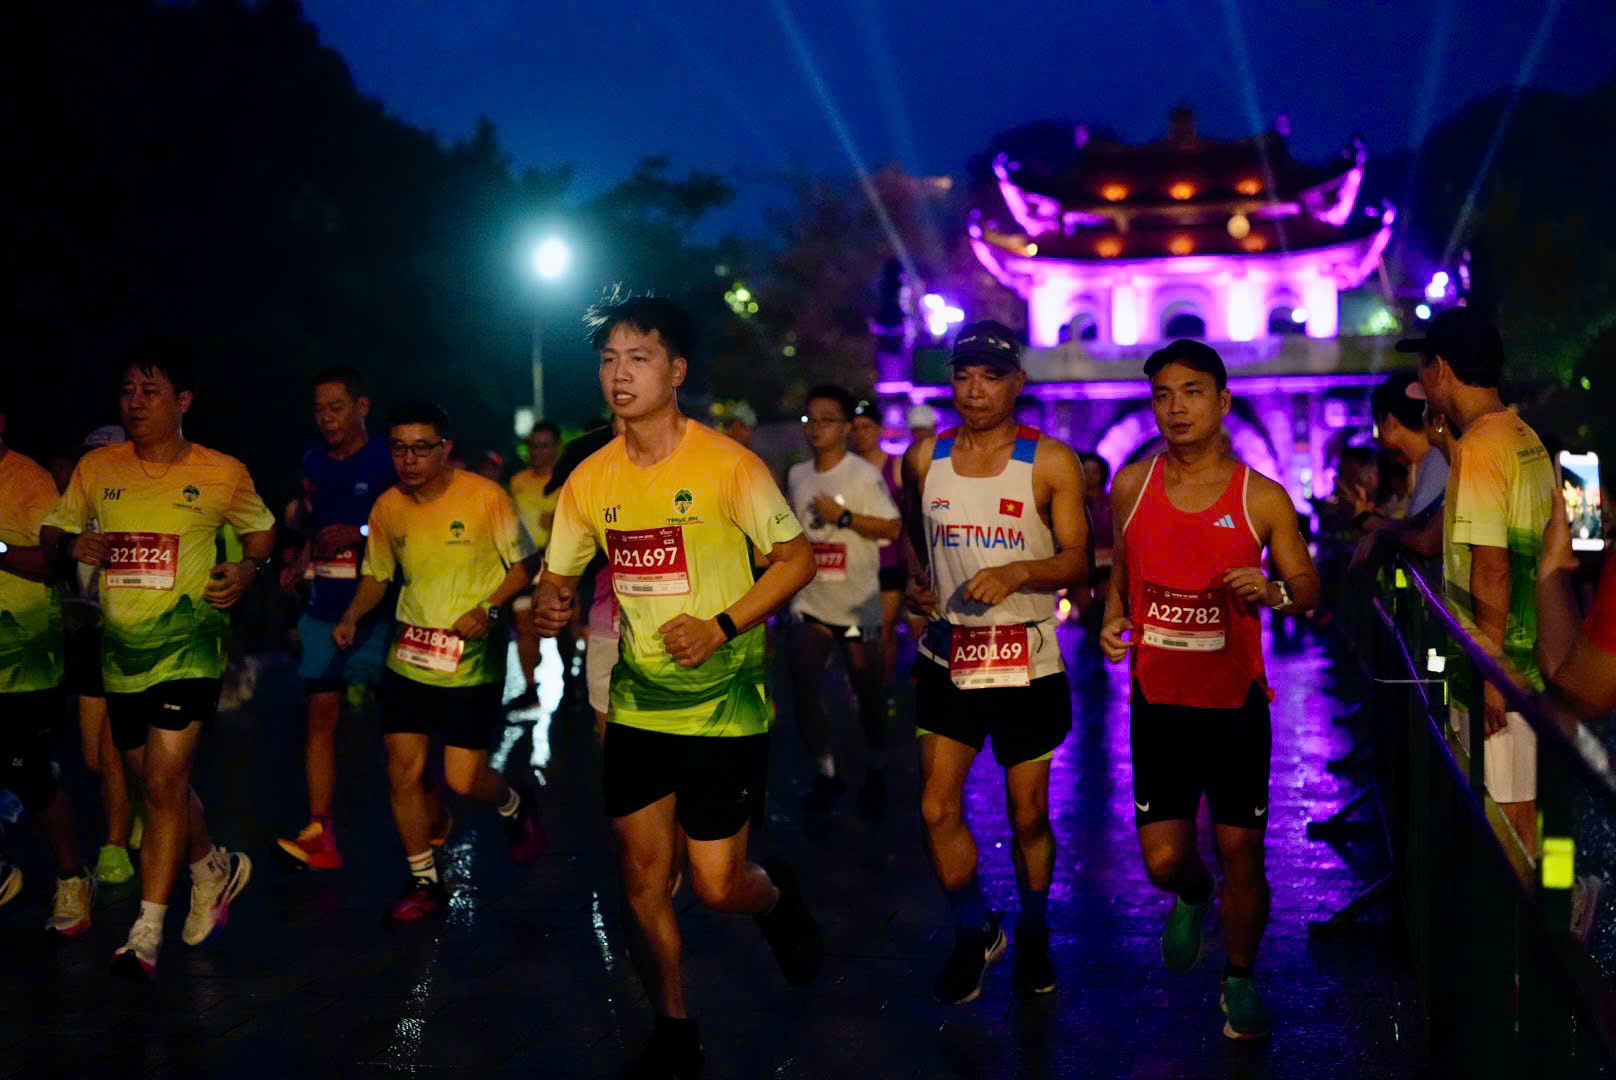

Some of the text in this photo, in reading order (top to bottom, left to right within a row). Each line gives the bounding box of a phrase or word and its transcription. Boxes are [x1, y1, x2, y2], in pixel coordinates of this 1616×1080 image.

[602, 504, 621, 523] 61°
[930, 523, 1025, 551] VIETNAM
[614, 546, 678, 567] A21697
[1147, 601, 1221, 624] A22782
[402, 625, 454, 648] A2180
[953, 641, 1023, 663] A20169
